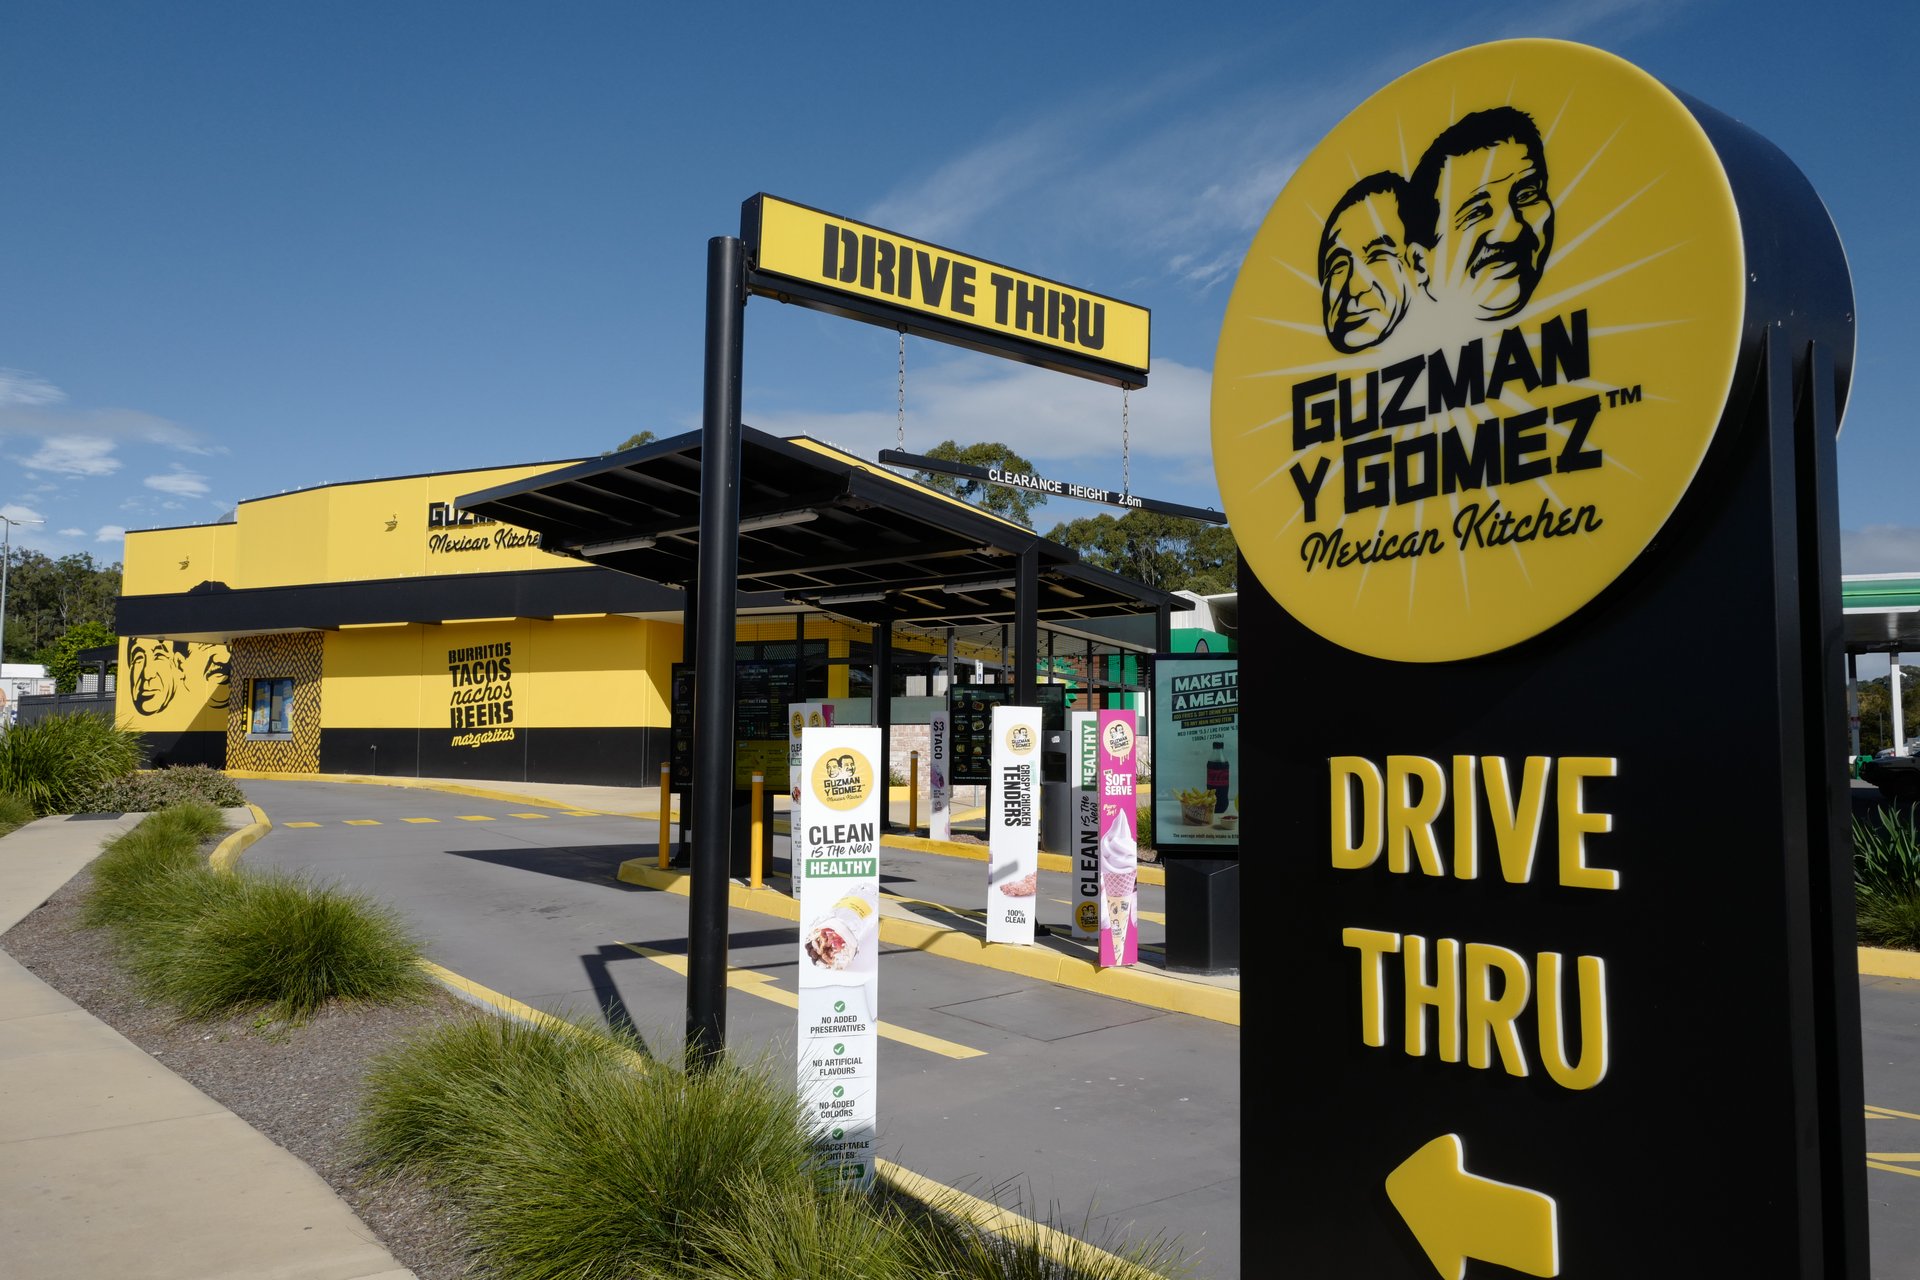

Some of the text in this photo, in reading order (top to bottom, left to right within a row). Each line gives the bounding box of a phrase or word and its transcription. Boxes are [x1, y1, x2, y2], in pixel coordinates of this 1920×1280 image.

[822, 223, 1105, 350] DRIVE THRU
[1292, 308, 1591, 451] GUZMAN
[1289, 456, 1331, 523] Y
[1343, 395, 1603, 514] GOMEZ
[989, 469, 1142, 508] CLEARANCE HEIGHT 2.6m
[429, 528, 541, 554] Mexican Kitche
[1301, 498, 1603, 572] Mexican Kitchen
[448, 642, 511, 664] BURRITOS
[449, 658, 511, 687] TACOS
[1175, 671, 1238, 692] MAKE IT
[450, 681, 512, 706] nachos
[1175, 695, 1188, 710] A
[450, 701, 513, 728] BEERS
[934, 721, 945, 732] $3
[452, 728, 515, 748] margaritas
[934, 732, 943, 760] TACO
[1084, 725, 1096, 786] HEALTHY
[823, 777, 860, 788] GUZMAN
[831, 785, 862, 795] GOMEZ
[1105, 773, 1132, 786] SOFT
[1105, 785, 1132, 796] SERVE
[1004, 765, 1021, 827] TENDERS
[1020, 765, 1032, 827] CRISPY CHICKEN
[1330, 755, 1620, 890] DRIVE
[809, 823, 874, 845] CLEAN
[811, 861, 872, 875] HEALTHY
[1081, 831, 1098, 897] CLEAN
[1005, 916, 1026, 924] CLEAN
[1007, 909, 1025, 917] 100%
[821, 1015, 857, 1024] NO ADDED
[1342, 927, 1608, 1090] THRU
[810, 1024, 865, 1034] PRESERVATIVES
[819, 1066, 856, 1076] FLAVOURS
[824, 1057, 863, 1066] ARTIFICIAL
[819, 1100, 855, 1109] NO ADDED
[820, 1109, 853, 1118] COLOURS
